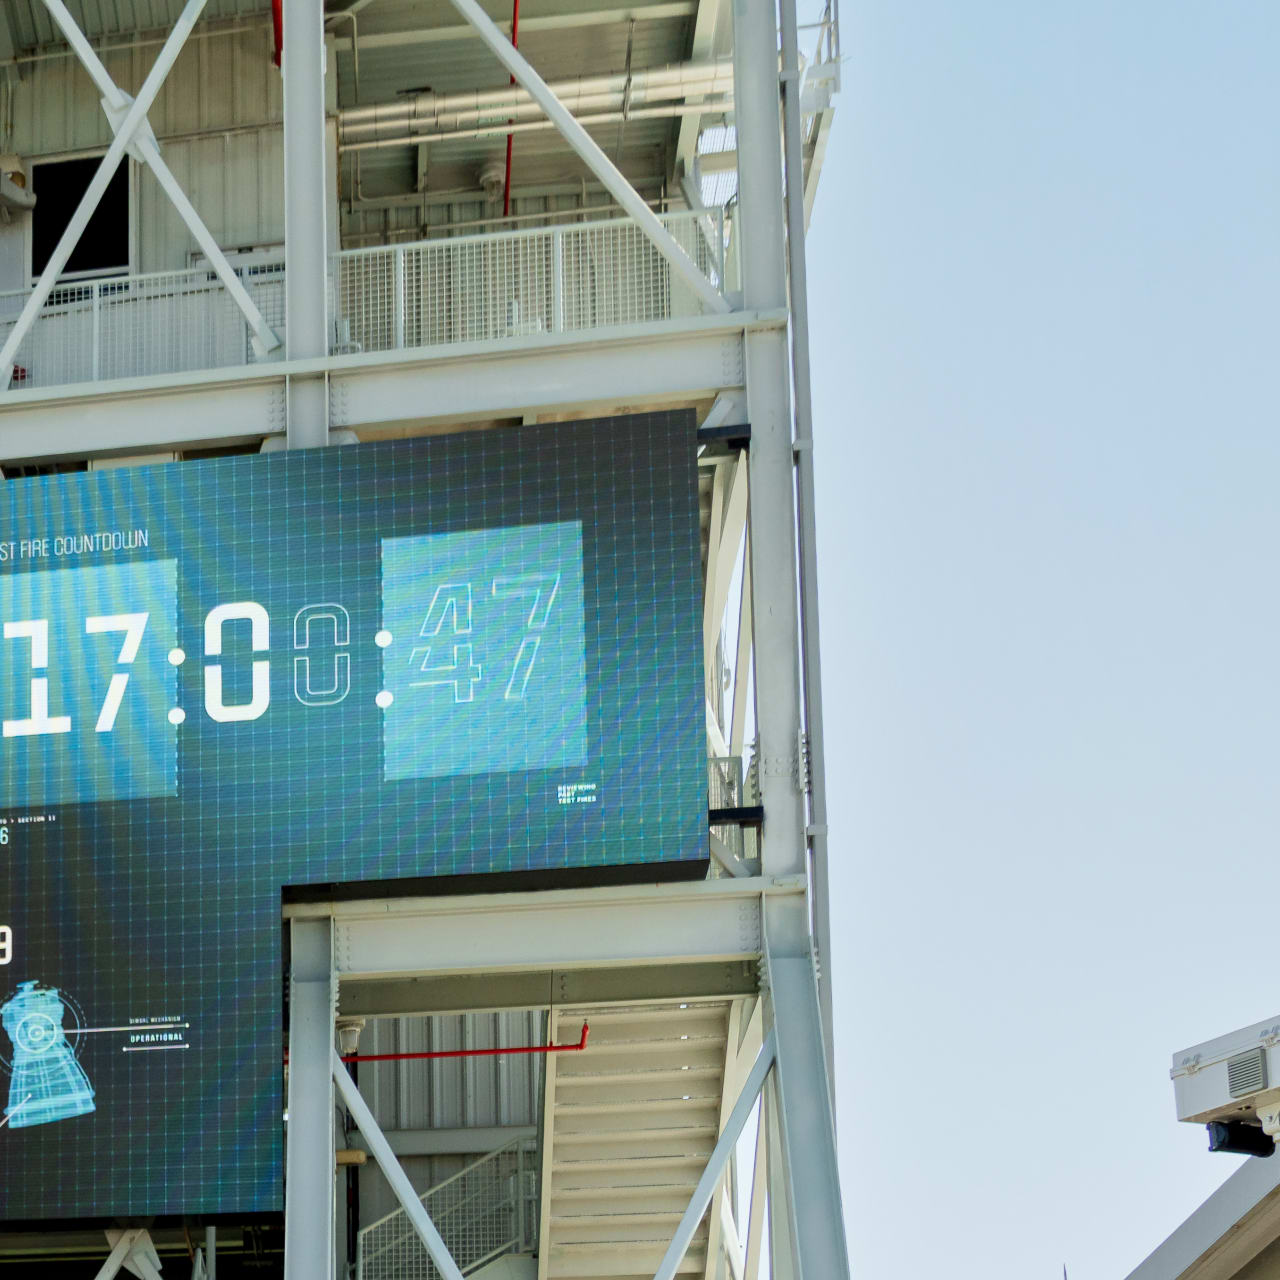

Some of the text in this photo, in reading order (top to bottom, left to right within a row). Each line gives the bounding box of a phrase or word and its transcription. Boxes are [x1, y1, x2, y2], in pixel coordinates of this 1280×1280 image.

[20, 539, 49, 558] FIRE
[54, 529, 149, 555] COUNTDOWN
[130, 1032, 183, 1043] OPERATIONAL
